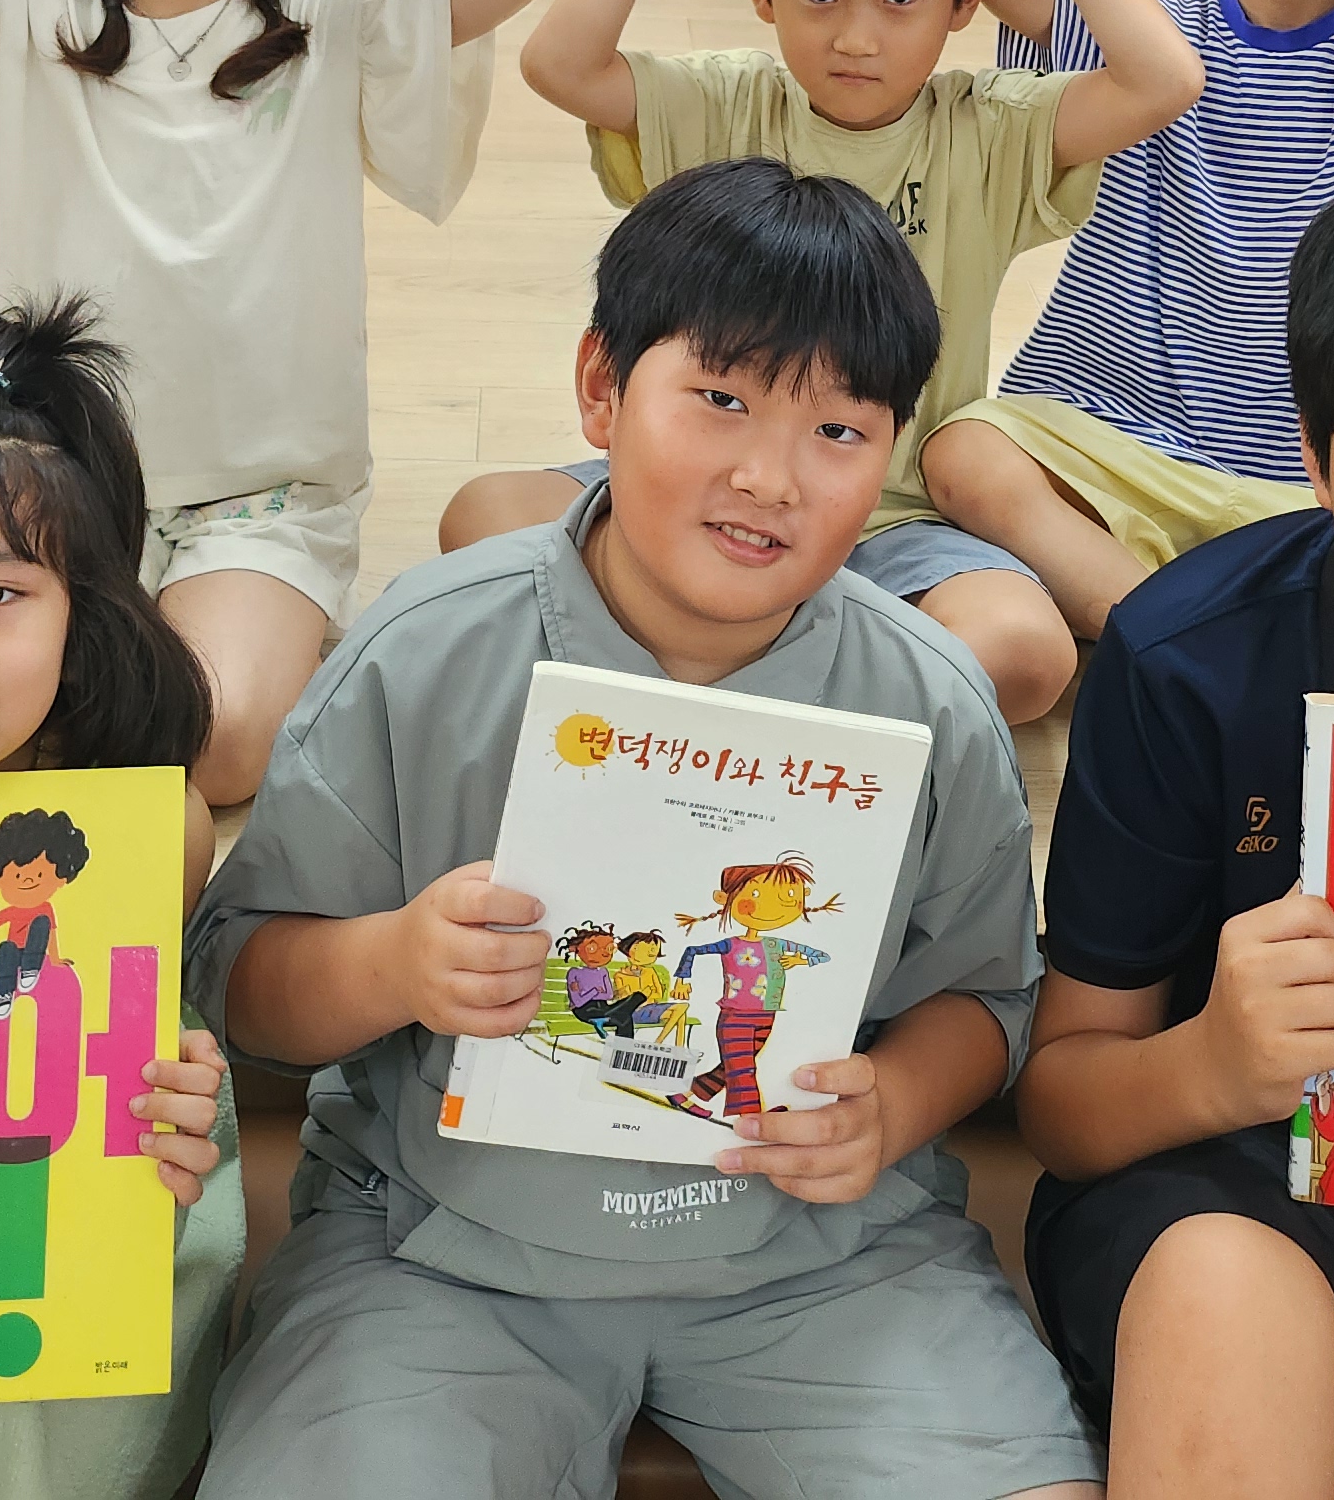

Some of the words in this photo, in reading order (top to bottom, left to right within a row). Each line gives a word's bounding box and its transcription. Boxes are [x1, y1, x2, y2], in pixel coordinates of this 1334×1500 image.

[579, 725, 765, 784] 변덕쟁이와
[779, 755, 883, 811] 친구들
[602, 1179, 732, 1215] MOVEMENT
[629, 1211, 702, 1229] ACTIVATE
